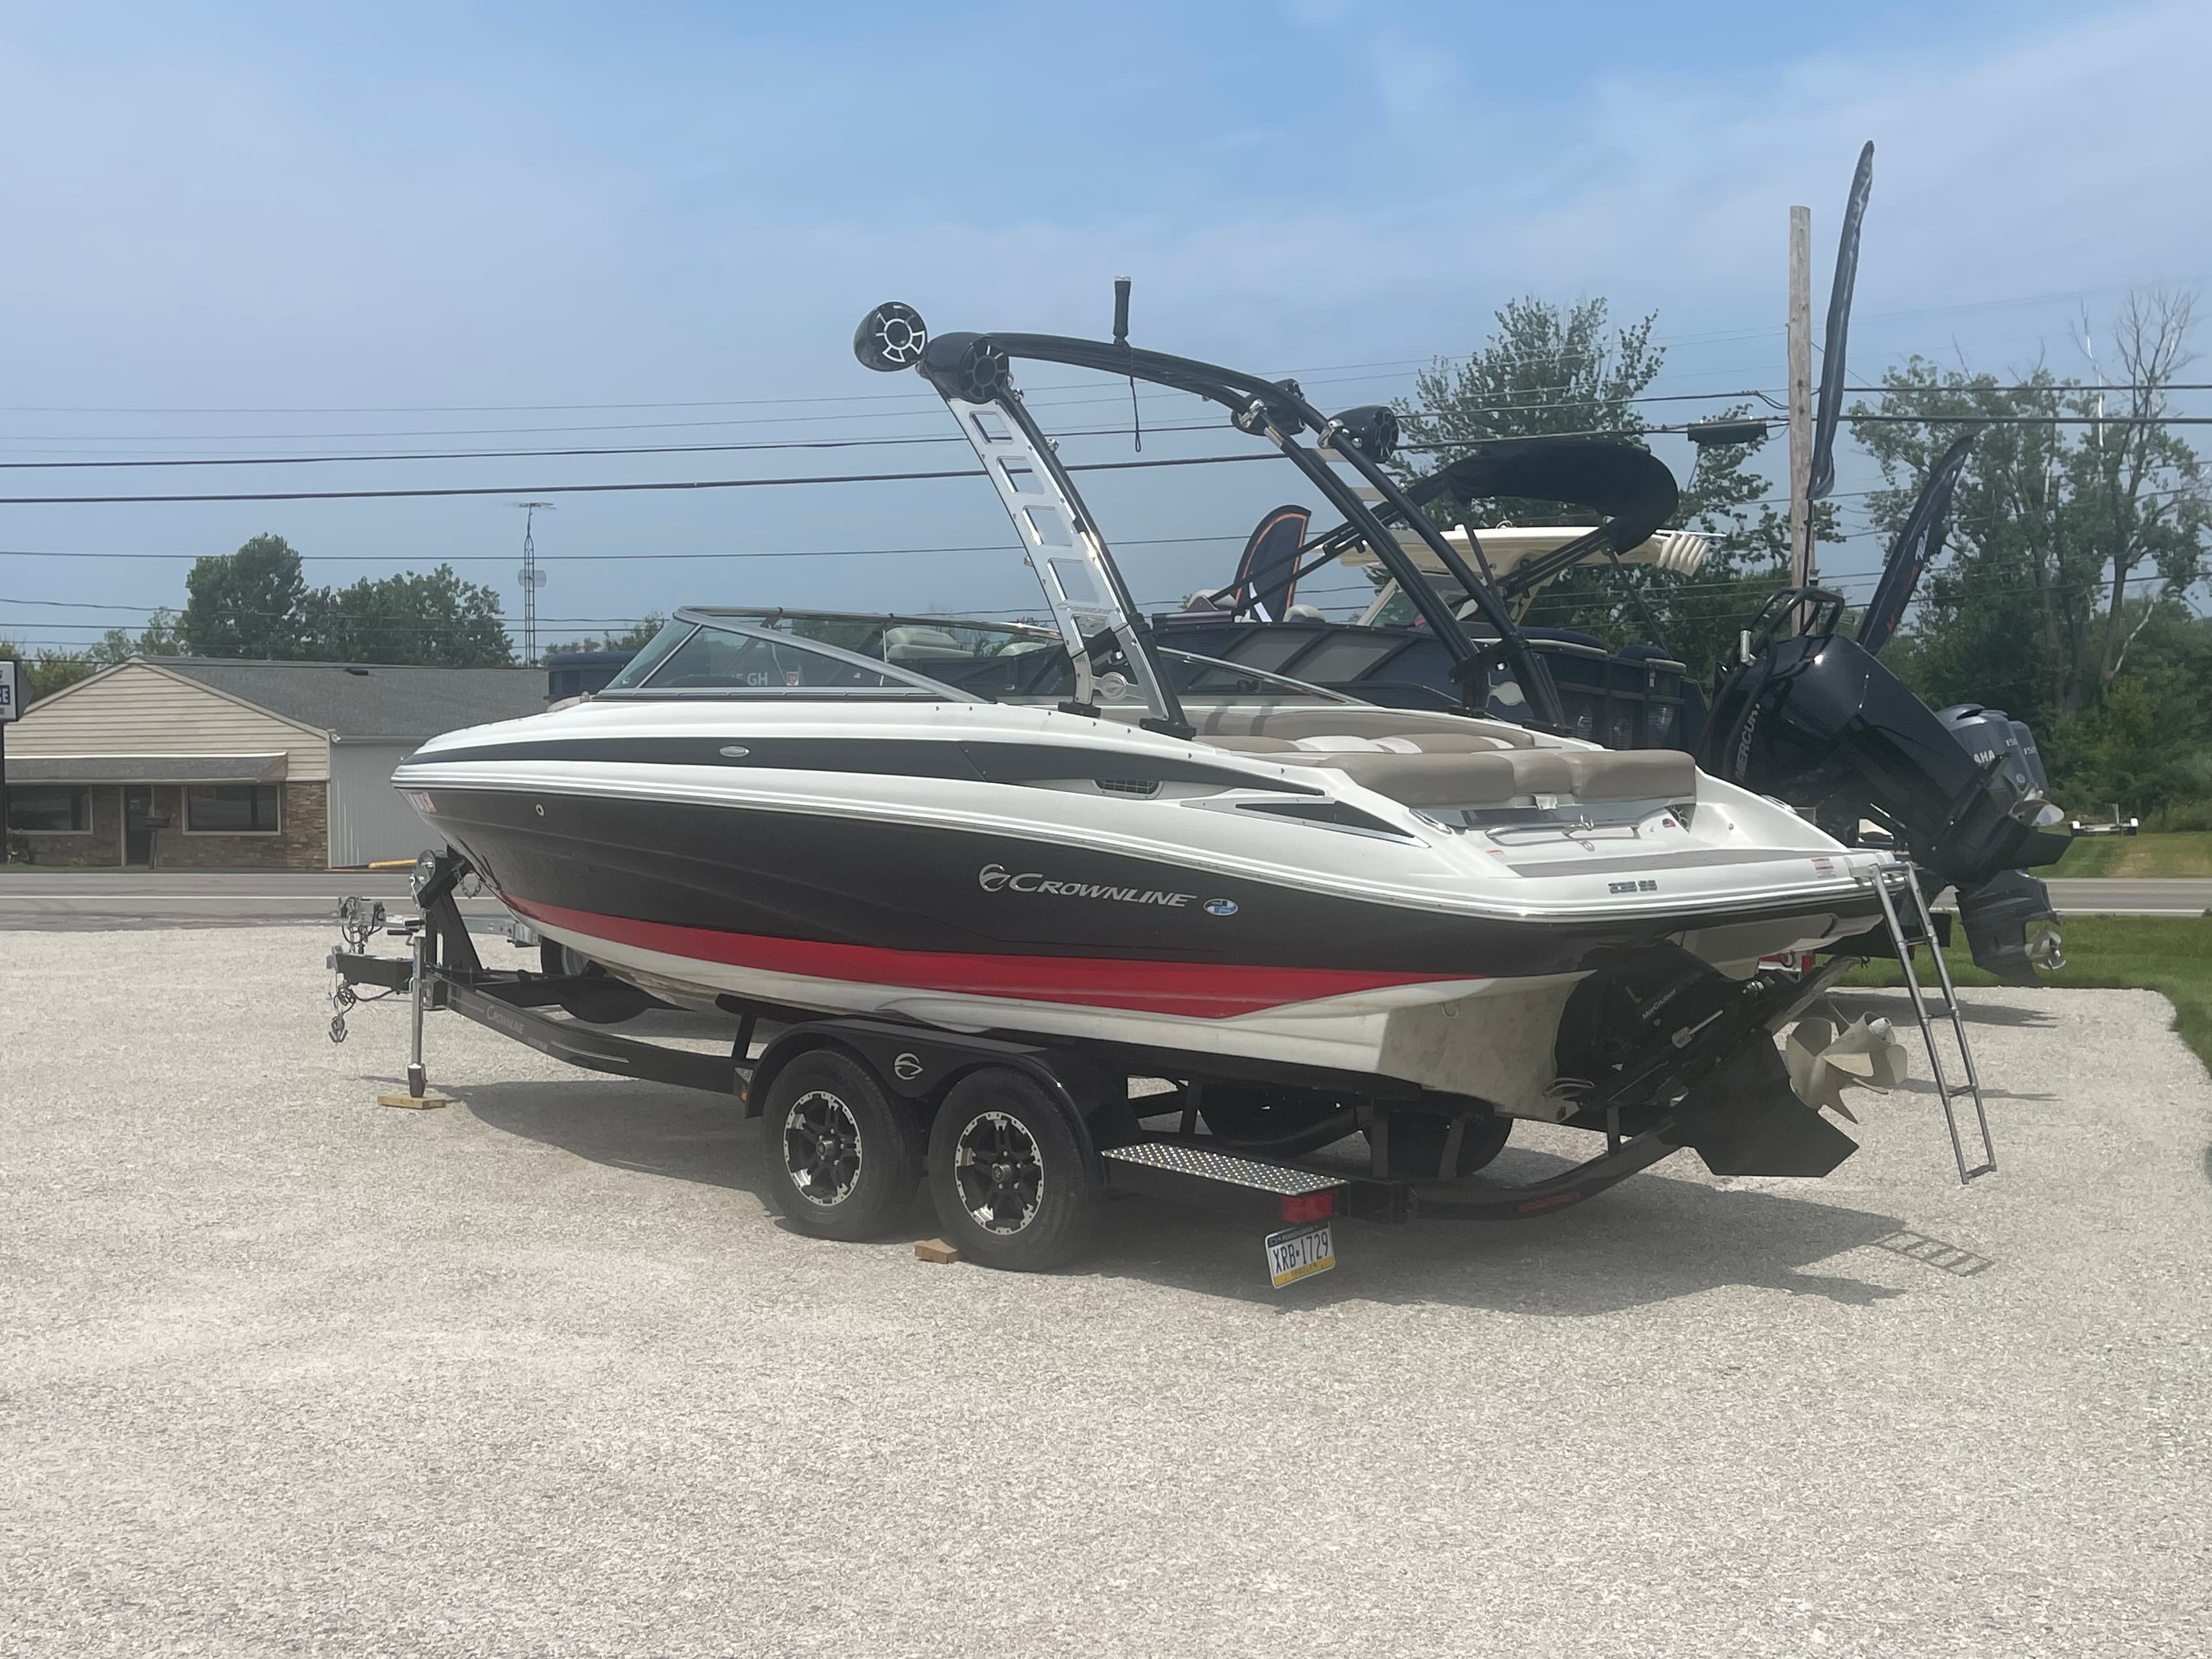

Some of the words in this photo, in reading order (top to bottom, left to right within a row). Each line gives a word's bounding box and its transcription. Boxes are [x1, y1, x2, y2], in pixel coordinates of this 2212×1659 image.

[747, 672, 768, 686] GH
[1734, 703, 1760, 782] MERCUR
[1974, 749, 1995, 764] AHA
[1009, 873, 1197, 907] CROWNLINE
